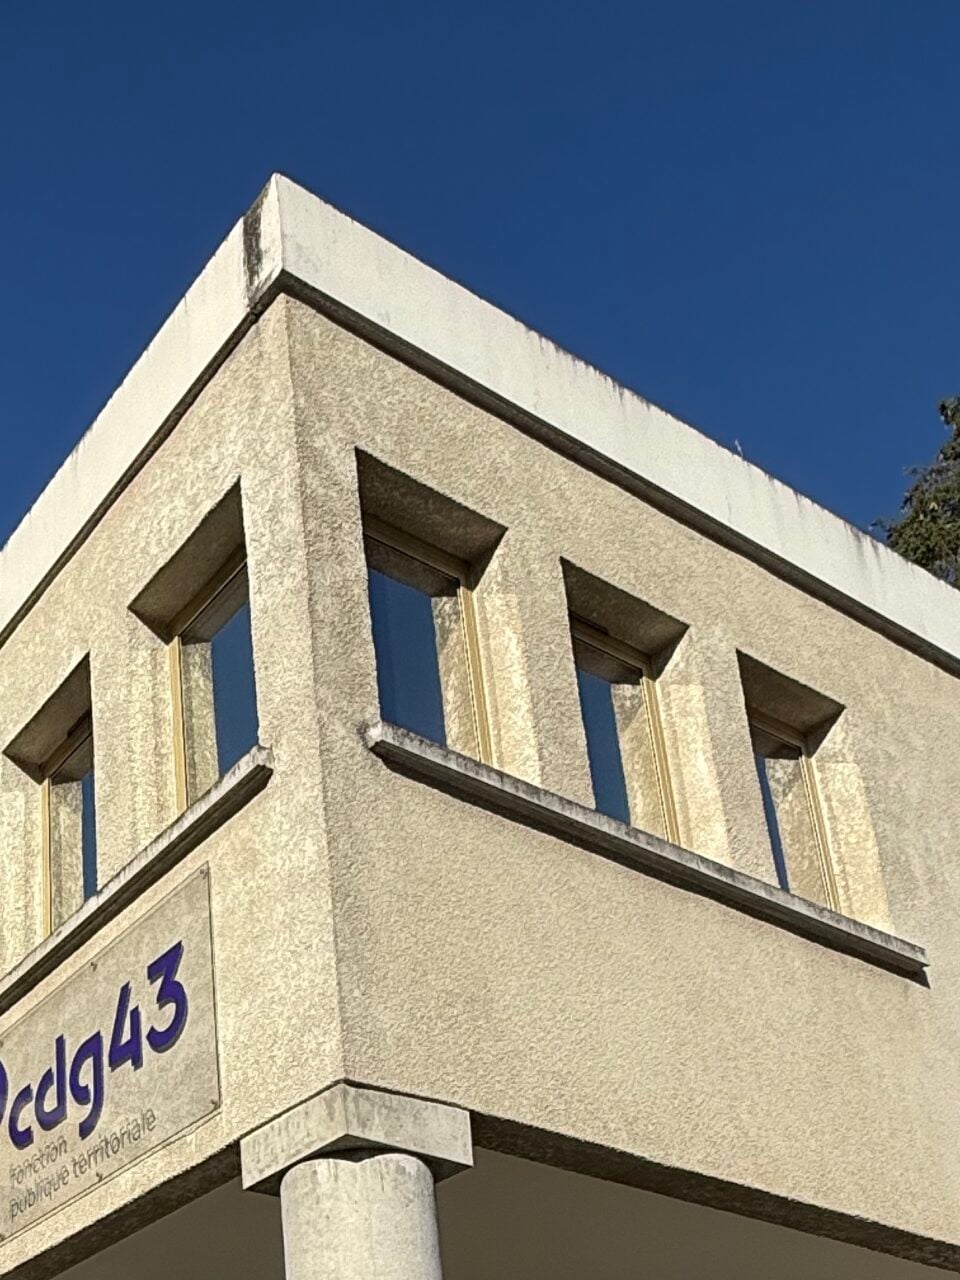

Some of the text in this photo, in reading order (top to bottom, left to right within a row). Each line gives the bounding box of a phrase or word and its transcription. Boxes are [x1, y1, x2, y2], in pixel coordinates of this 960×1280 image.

[8, 940, 188, 1150] cdg43
[10, 1108, 156, 1221] publique territoriale
